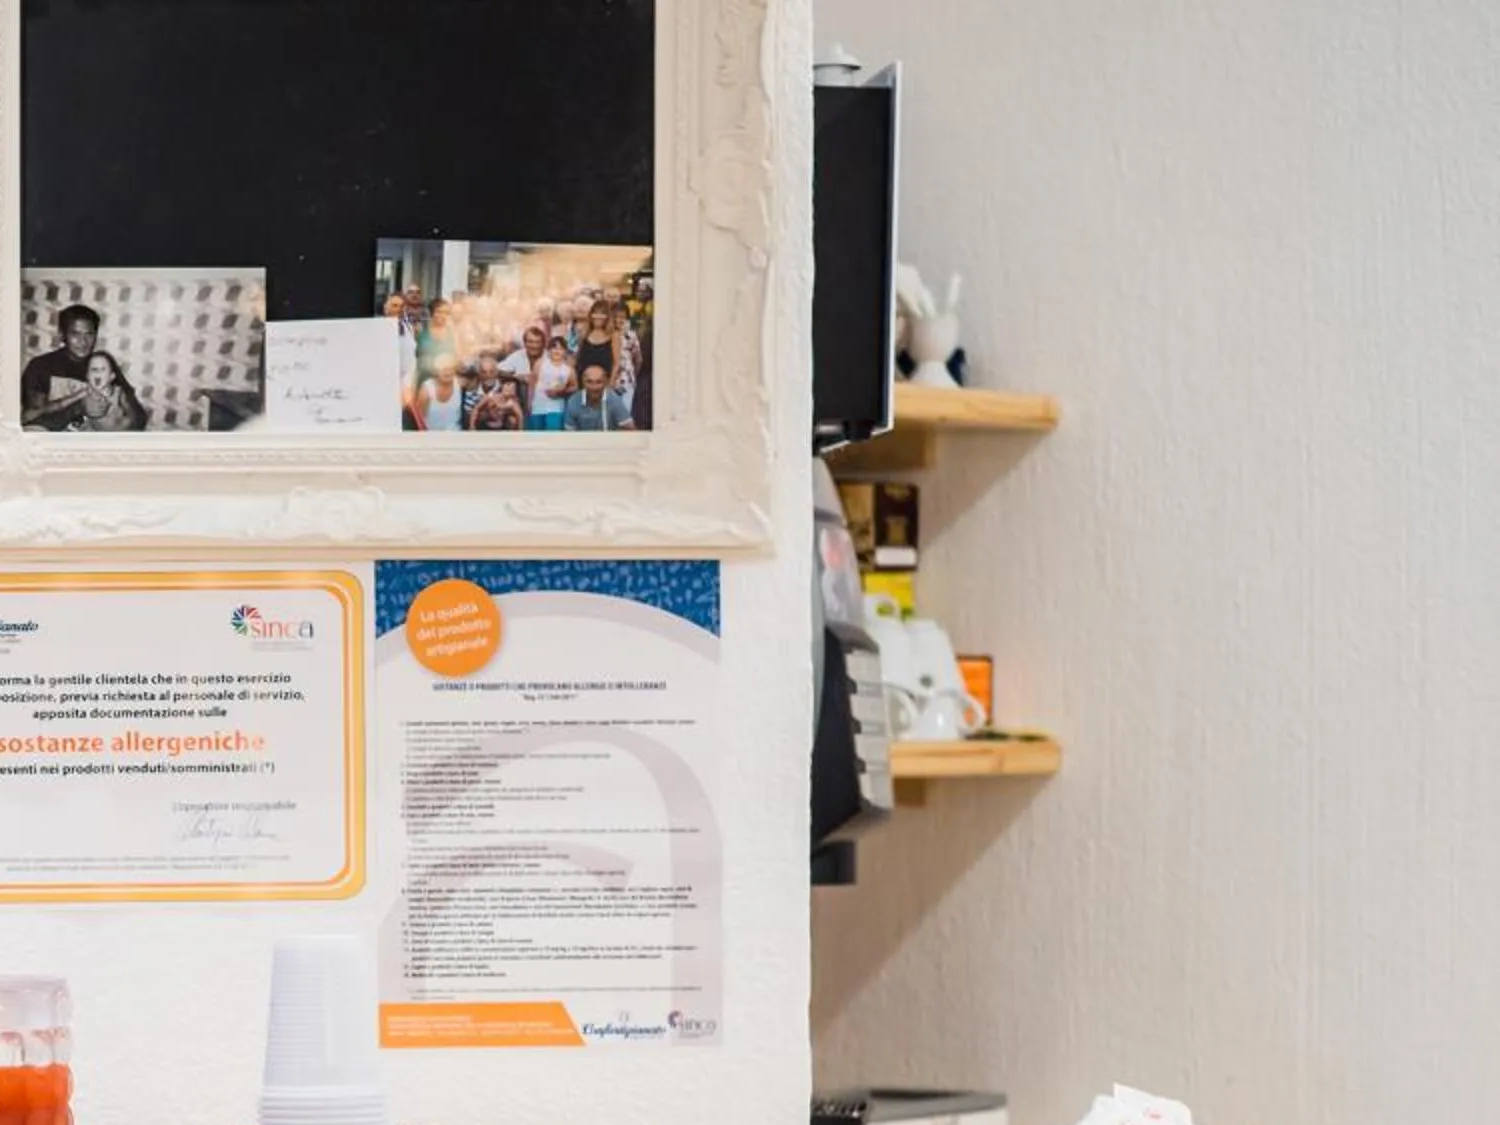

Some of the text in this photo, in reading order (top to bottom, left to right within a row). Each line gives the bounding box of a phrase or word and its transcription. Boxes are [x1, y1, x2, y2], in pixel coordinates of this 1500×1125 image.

[34, 675, 45, 685] la
[48, 674, 93, 688] gentile
[95, 673, 148, 685] clientela
[150, 673, 173, 684] che
[175, 674, 187, 684] in
[190, 674, 234, 688] questo
[236, 673, 292, 684] esercizio
[60, 692, 99, 704] previa
[102, 691, 156, 701] richiesta
[159, 690, 170, 701] al
[173, 690, 235, 703] personale
[237, 690, 250, 701] di
[253, 689, 306, 702] servizio,
[32, 706, 228, 720] apposita documentazione sulle
[110, 730, 266, 757] allergeniche
[40, 763, 60, 775] nei
[62, 762, 115, 776] prodotti
[117, 762, 257, 774] venduti/somministrati
